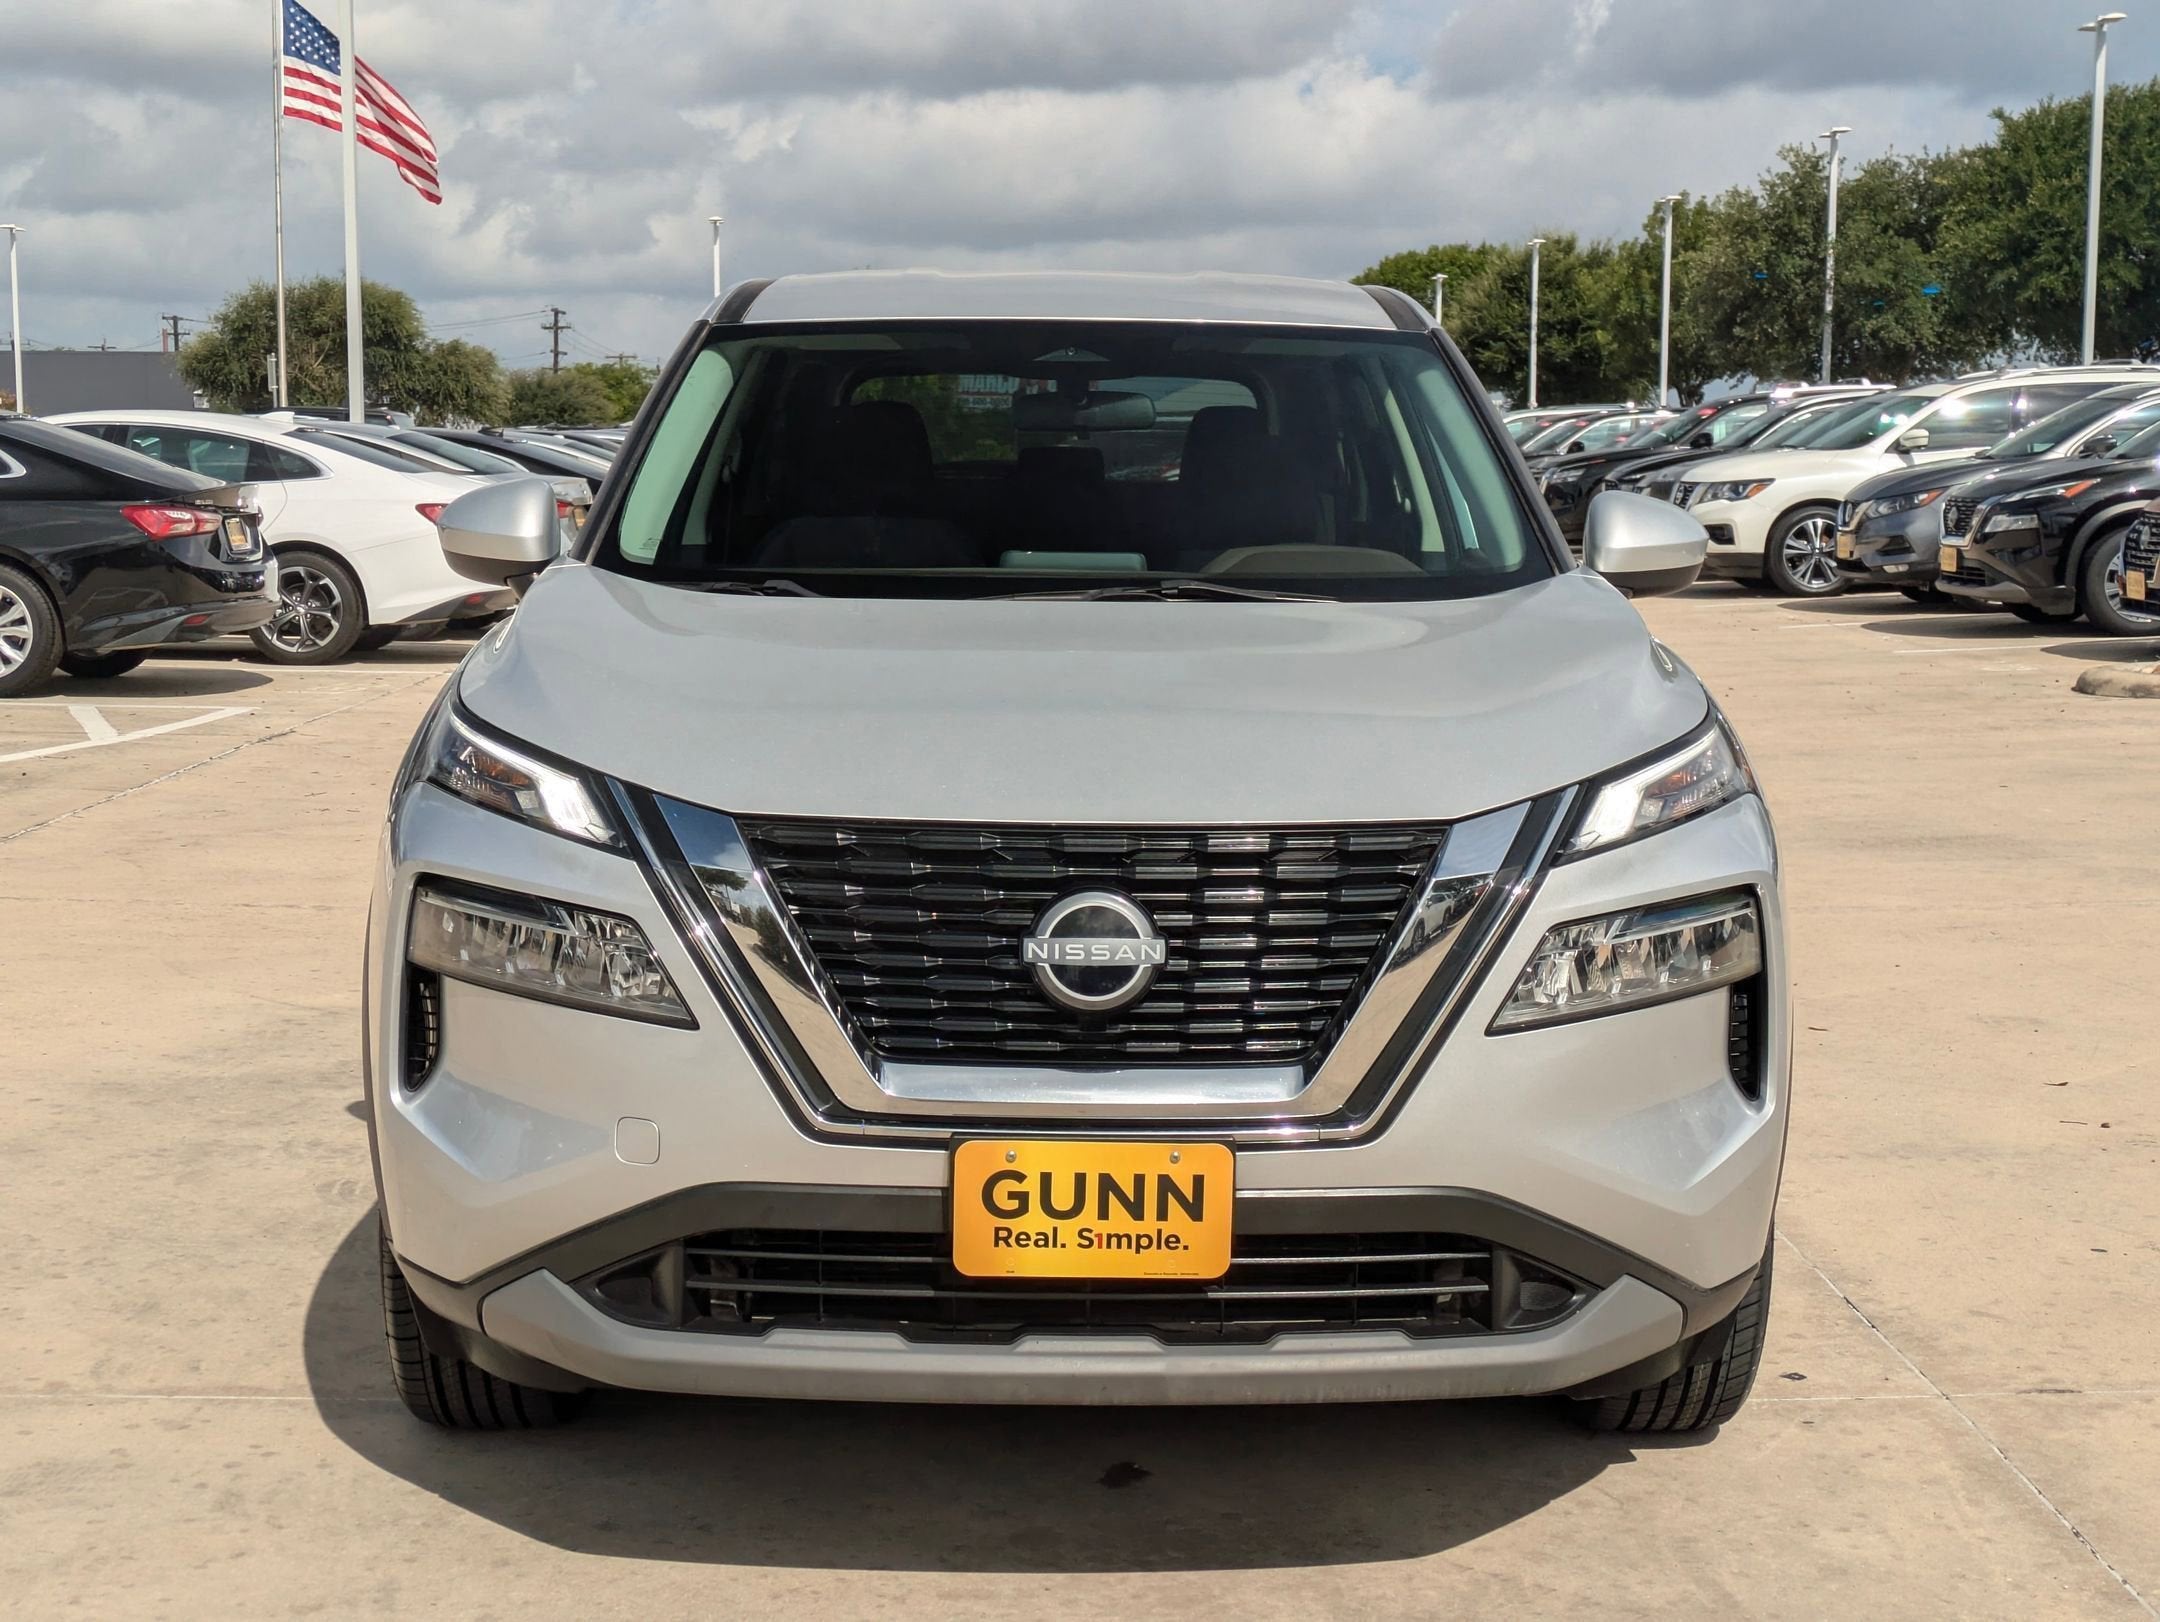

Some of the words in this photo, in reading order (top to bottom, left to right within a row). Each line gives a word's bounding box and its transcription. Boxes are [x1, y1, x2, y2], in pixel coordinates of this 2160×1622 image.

[1027, 942, 1161, 961] NISSAN
[981, 1169, 1205, 1222] GUNN
[992, 1226, 1067, 1249] Real.
